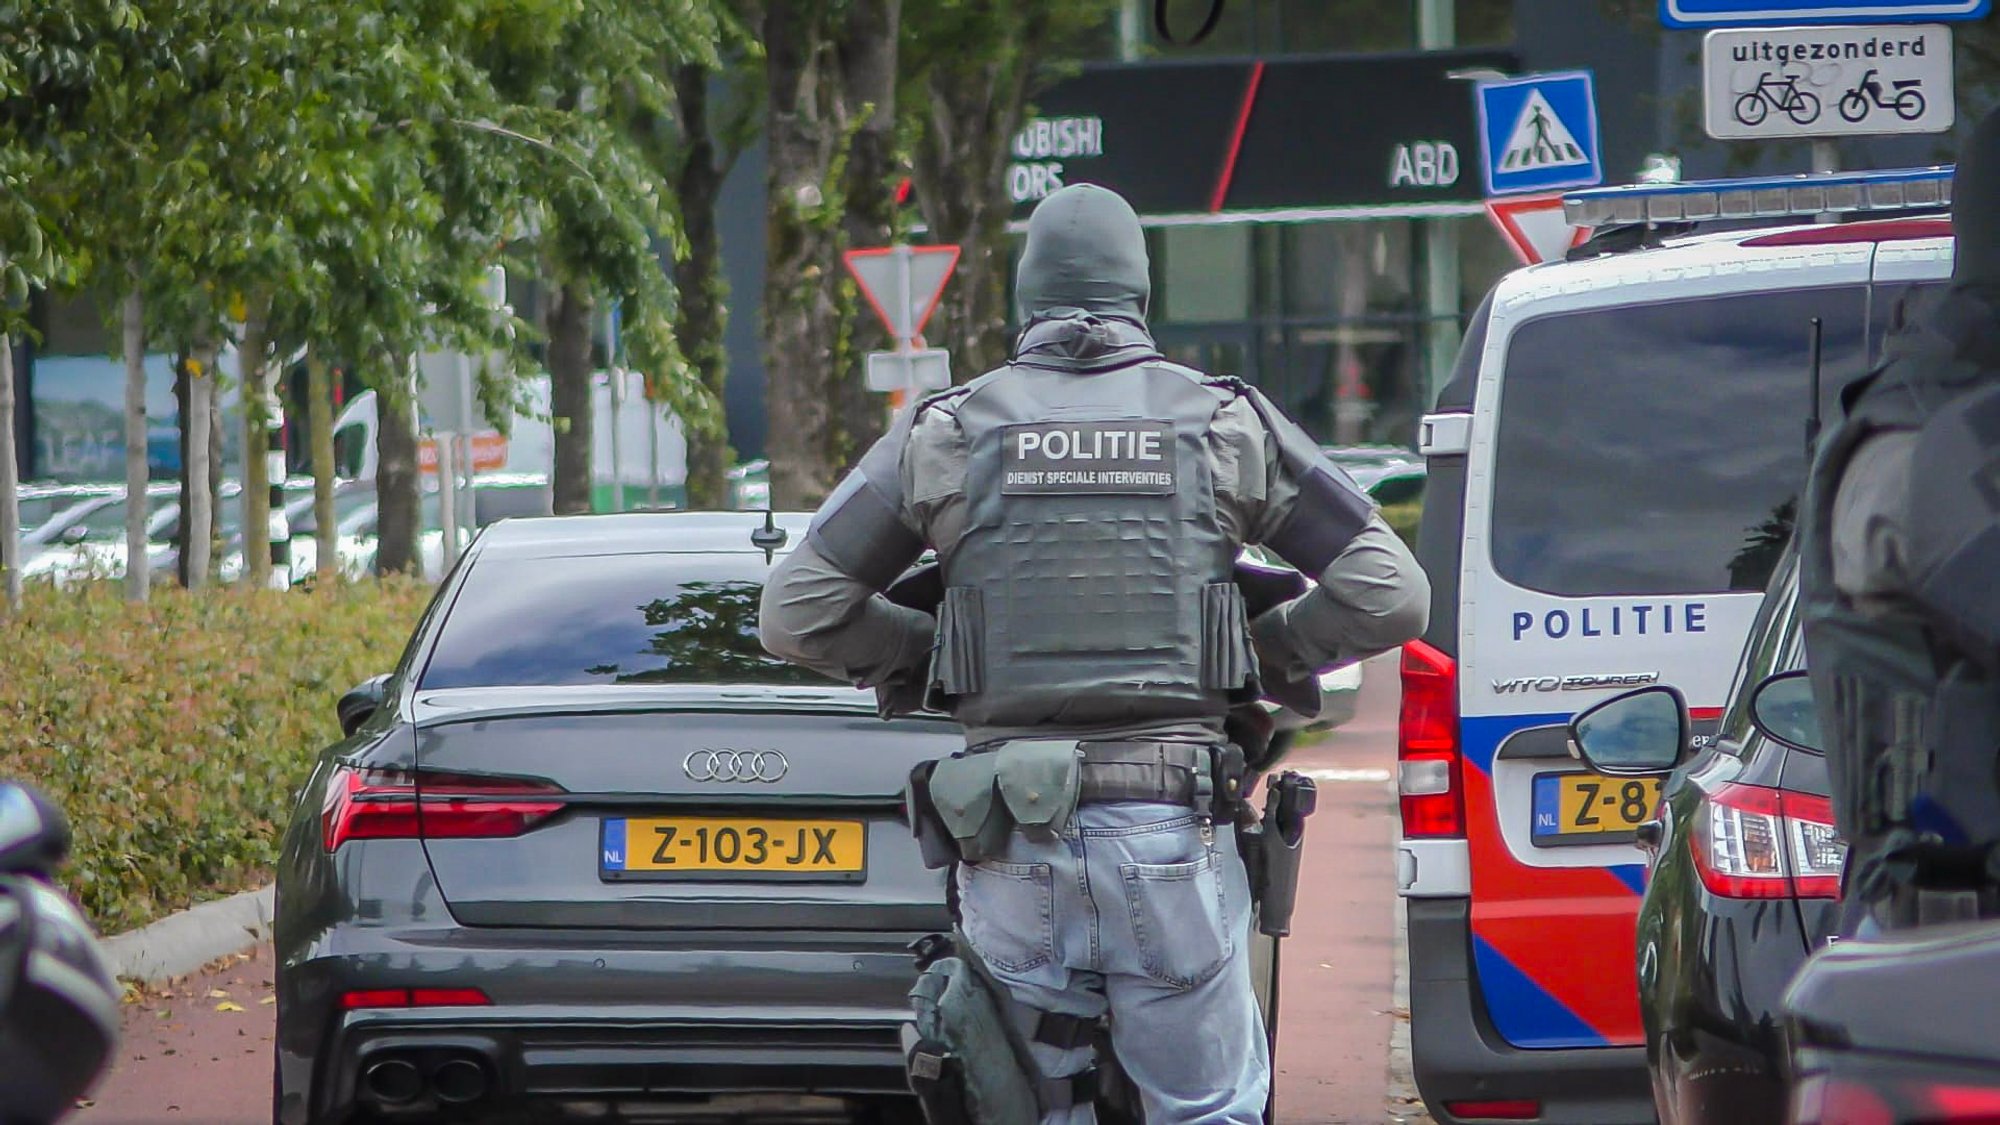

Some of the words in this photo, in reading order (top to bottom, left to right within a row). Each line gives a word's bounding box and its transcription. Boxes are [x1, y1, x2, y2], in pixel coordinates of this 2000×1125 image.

[1732, 36, 1926, 66] uitgezonderd
[1390, 143, 1460, 186] ABD
[1018, 430, 1162, 461] POLITIE
[1007, 471, 1045, 485] DIENST
[1046, 471, 1096, 485] SPECIALE
[1098, 471, 1172, 486] INTERVENTIES
[1512, 602, 1707, 642] POLITIE
[1491, 675, 1562, 695] VITO
[1564, 671, 1660, 691] TOURER
[1538, 813, 1557, 827] NL
[1575, 780, 1663, 827] Z-8
[604, 850, 623, 864] NL
[652, 826, 837, 865] Z-103-JX
